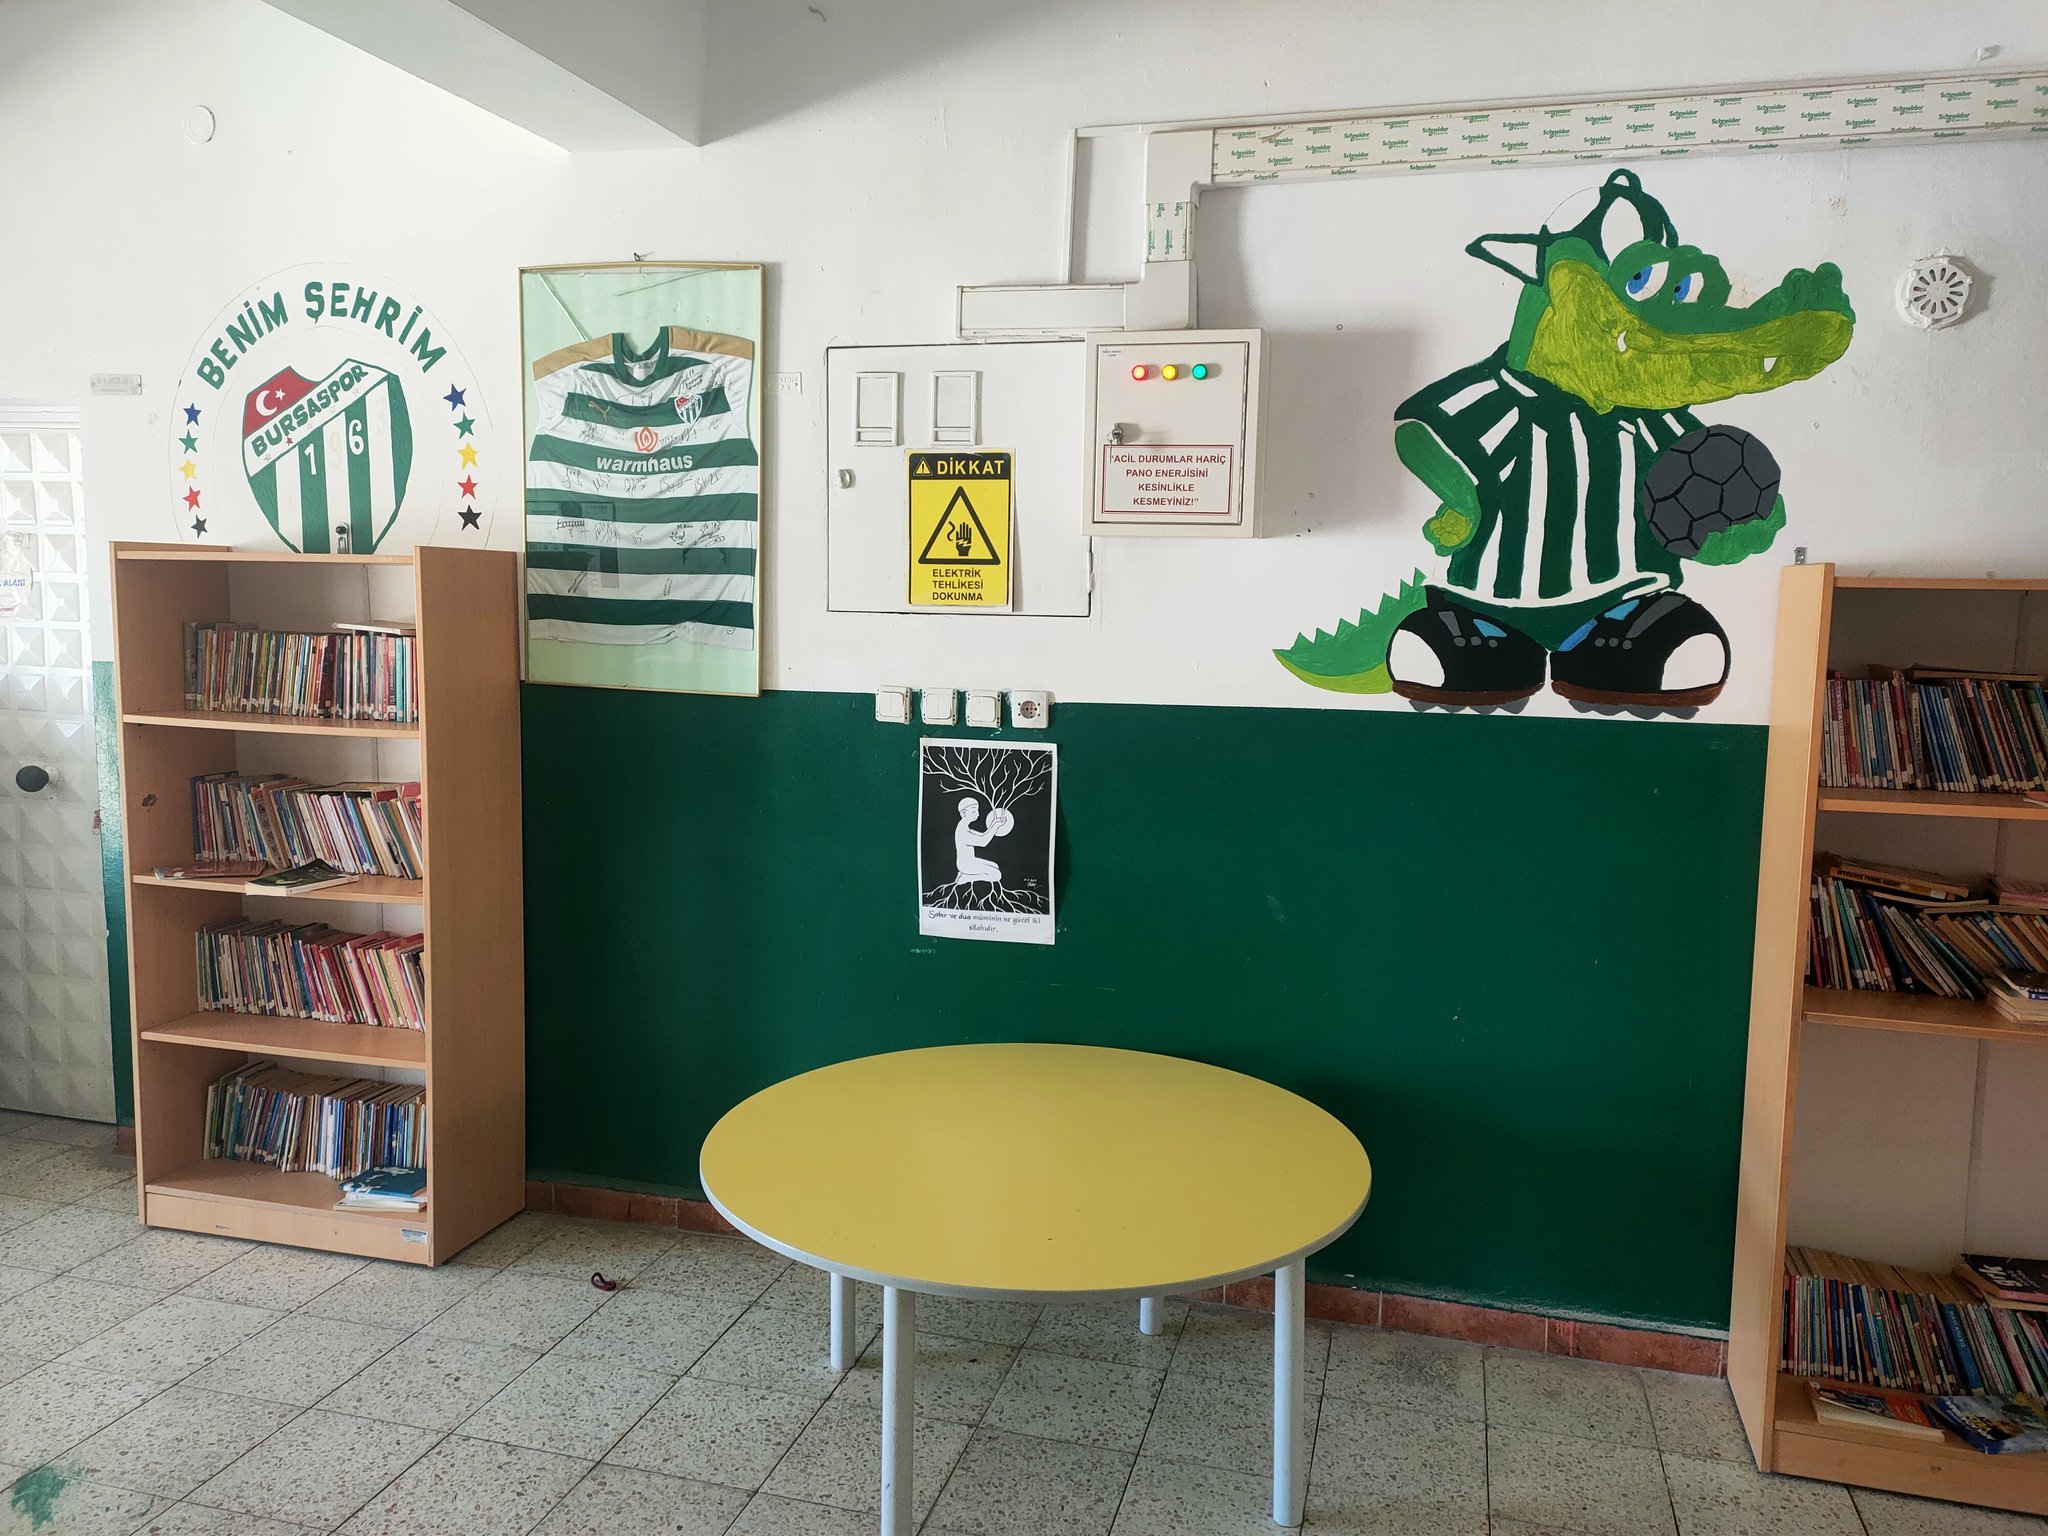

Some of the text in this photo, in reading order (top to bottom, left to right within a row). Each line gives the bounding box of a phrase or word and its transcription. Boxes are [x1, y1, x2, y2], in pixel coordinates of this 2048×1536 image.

[196, 281, 447, 390] BENİM ŞEHRİM
[251, 365, 369, 457] BURSASPOR
[304, 443, 317, 476] 1
[348, 419, 365, 456] 6
[596, 455, 693, 473] warmhaus
[1138, 454, 1193, 464] DURUMLAR
[1195, 453, 1227, 465] HARİÇ
[937, 457, 1005, 475] DİKKAT
[1126, 467, 1209, 478] PANO ENERJİSİNİ
[1138, 481, 1195, 492] KESİNLİKLE
[932, 567, 981, 578] ELEKTRİK
[932, 579, 984, 590] TEHLİKESİ
[932, 591, 984, 601] DOKUNMA
[958, 912, 971, 920] dua
